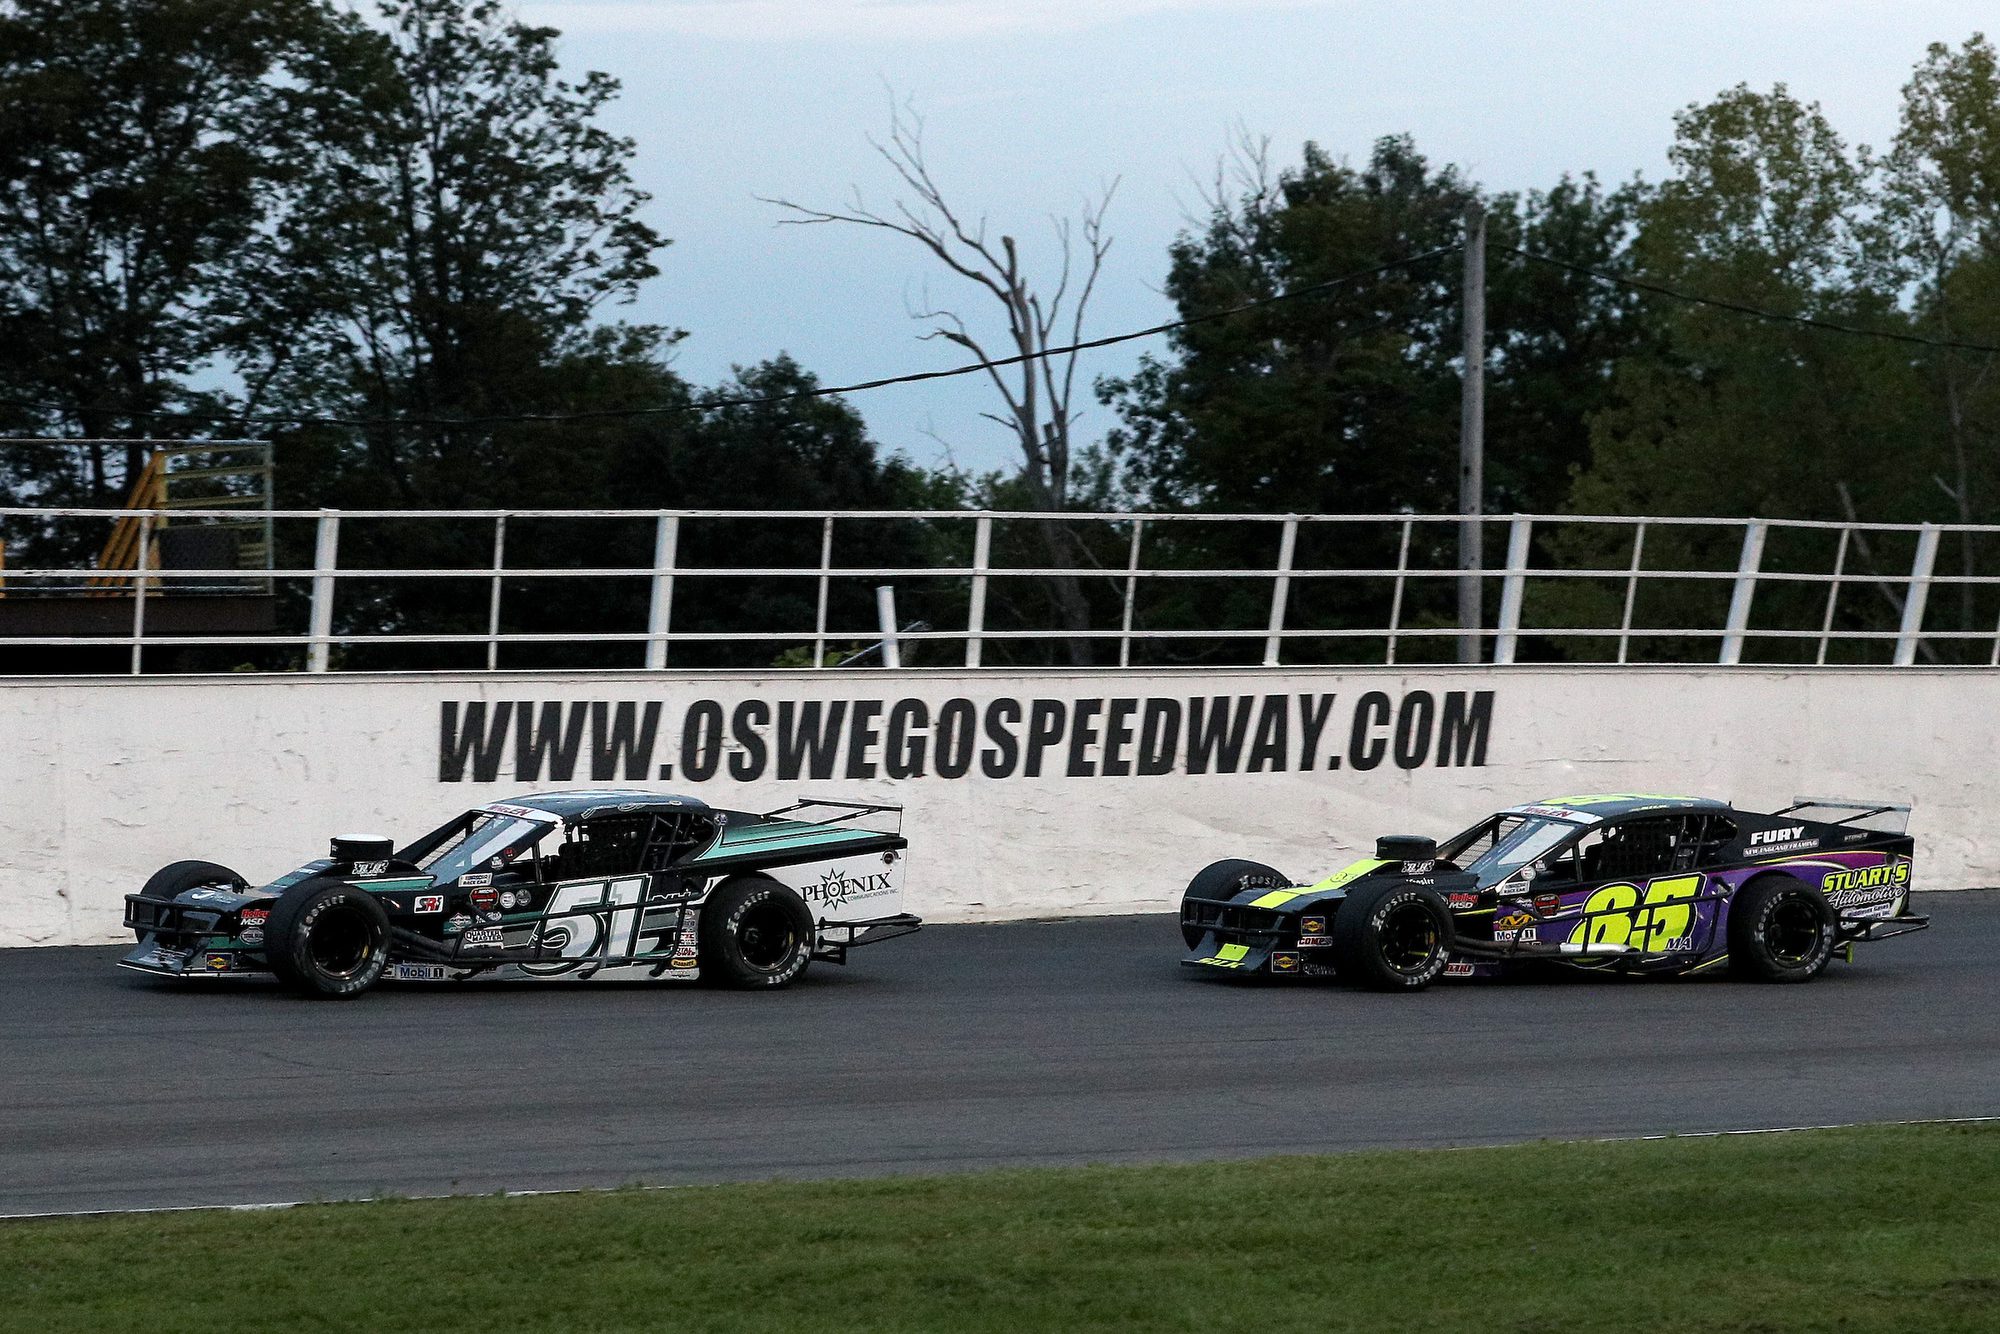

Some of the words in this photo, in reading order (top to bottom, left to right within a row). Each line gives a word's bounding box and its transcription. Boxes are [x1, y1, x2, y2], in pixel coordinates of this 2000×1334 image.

[439, 690, 1495, 783] WWW.OSWEGOSPEEDWAY.COM
[1750, 826, 1805, 845] FURY
[801, 872, 891, 902] PHOENIX
[1822, 864, 1908, 893] STUART'S
[1828, 887, 1905, 909] Automotive
[240, 918, 265, 926] MSD
[519, 874, 651, 977] 51
[1567, 874, 1704, 965] 85
[1665, 937, 1692, 950] MA
[401, 966, 431, 978] Mobil
